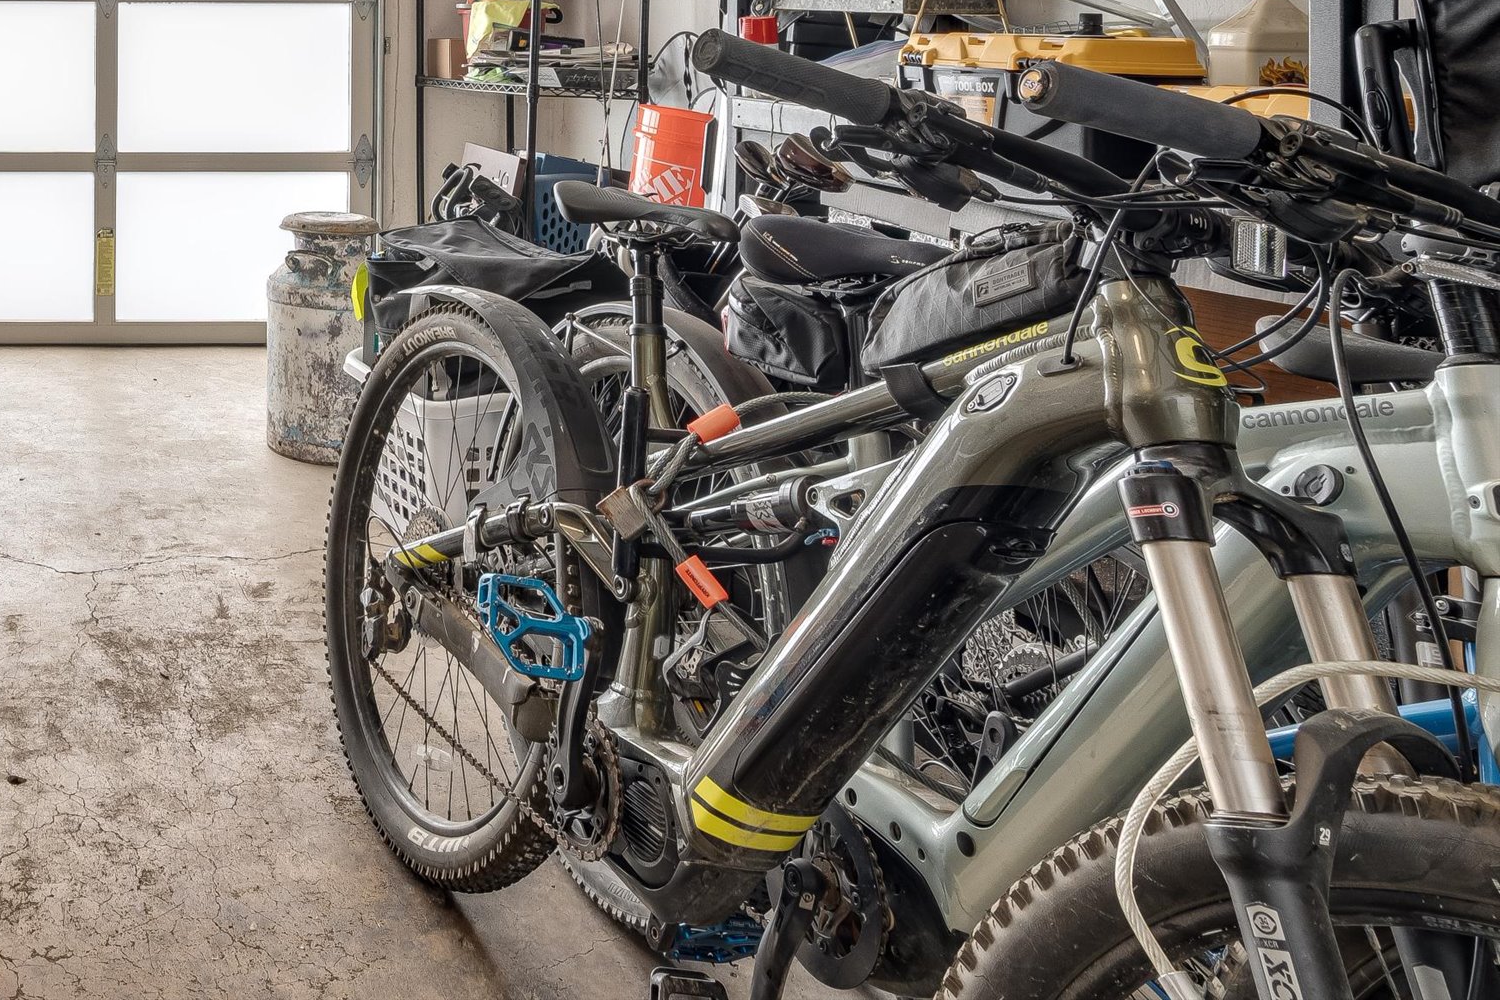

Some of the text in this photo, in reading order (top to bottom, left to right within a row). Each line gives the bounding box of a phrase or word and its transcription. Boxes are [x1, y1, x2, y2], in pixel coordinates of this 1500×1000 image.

[955, 81, 995, 93] TOOL BOX
[402, 325, 458, 357] BREAKOUT
[407, 826, 465, 853] WTB
[1319, 827, 1331, 841] 29
